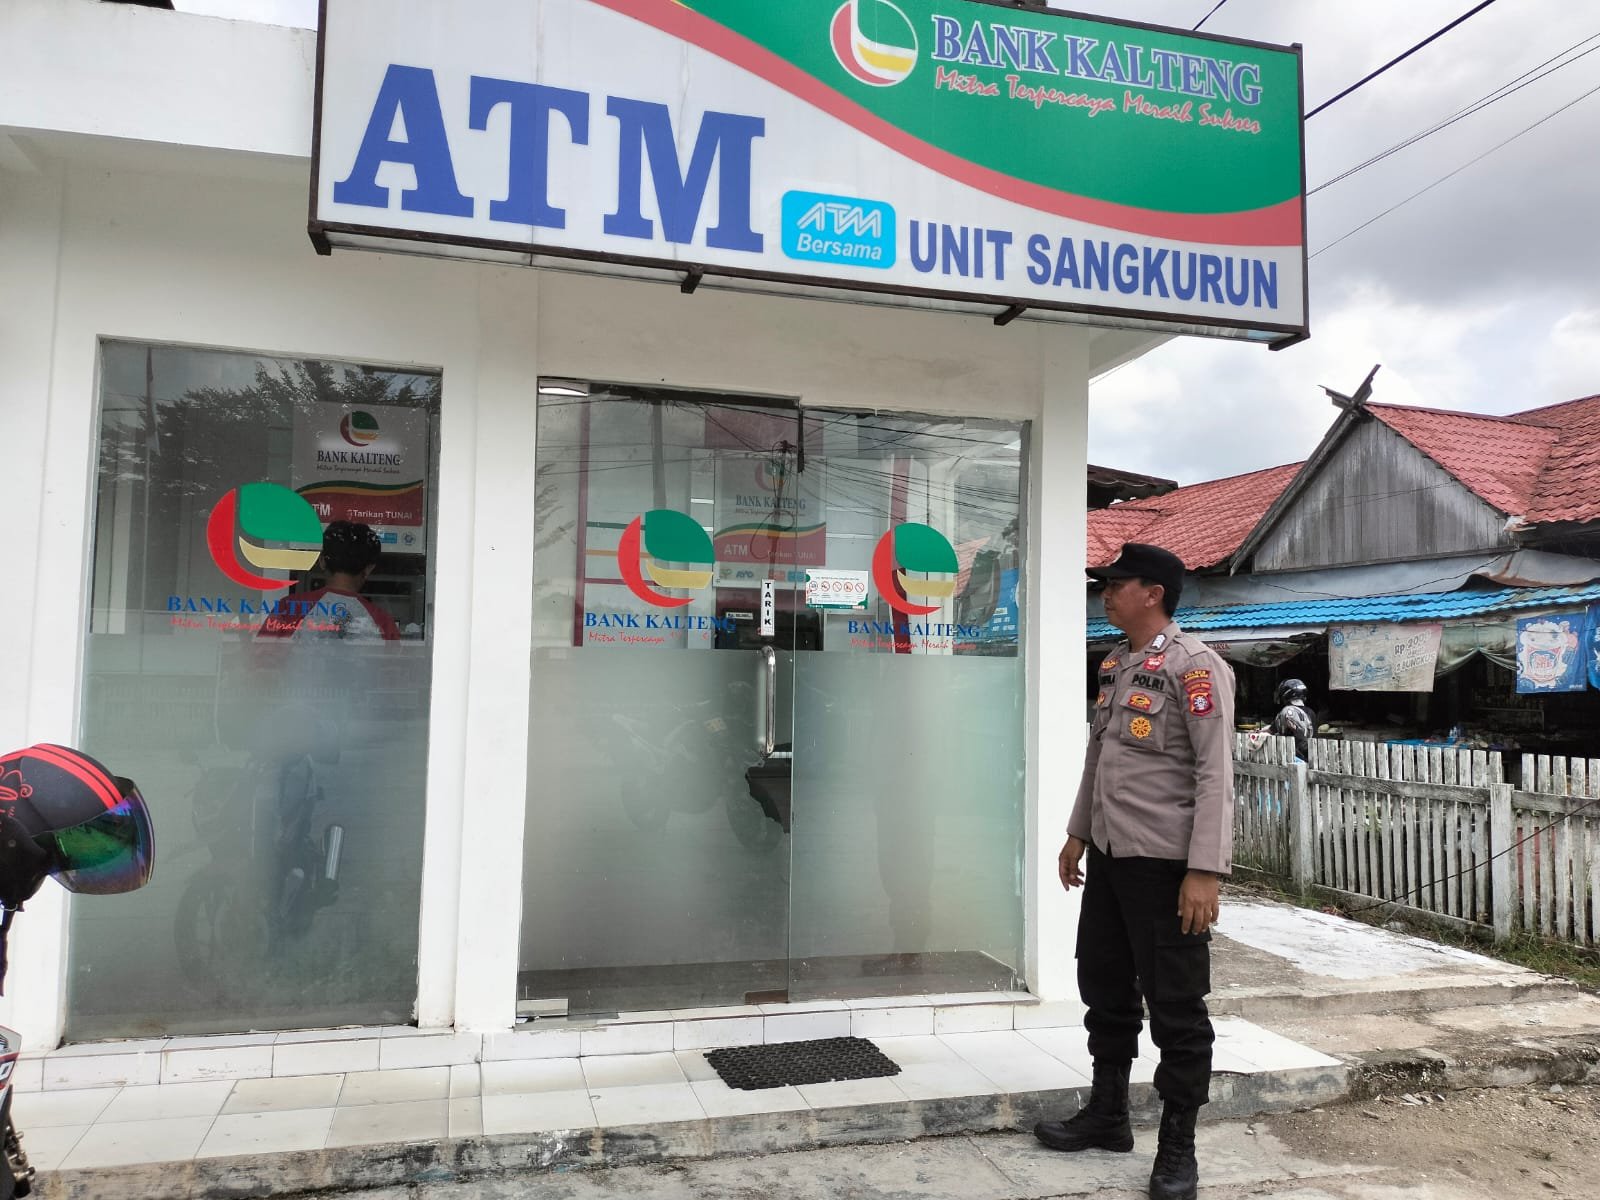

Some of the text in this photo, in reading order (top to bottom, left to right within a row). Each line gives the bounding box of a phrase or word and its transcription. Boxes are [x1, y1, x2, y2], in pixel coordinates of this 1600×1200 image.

[932, 15, 1262, 106] BANK KALTENG
[935, 66, 1261, 133] Mitra Terpercaya Meraih Sukses
[333, 63, 765, 253] ATM
[797, 202, 882, 238] ATM
[797, 233, 882, 260] Bersama
[909, 220, 1279, 310] UNIT SANGKURUN
[317, 450, 401, 466] BANK KALTENG
[311, 503, 331, 516] TM
[736, 494, 762, 507] BANK
[353, 510, 412, 519] Tarikan TUNAI
[724, 544, 748, 556] ATM
[168, 595, 347, 617] BANK KALTENG
[764, 582, 772, 625] TARIK
[585, 612, 644, 628] BANK
[646, 614, 736, 632] KALTENG
[848, 620, 979, 637] BANK KALTENG
[588, 631, 616, 642] Mitra
[620, 631, 665, 644] Terpercaya
[1132, 674, 1165, 690] POLRI
